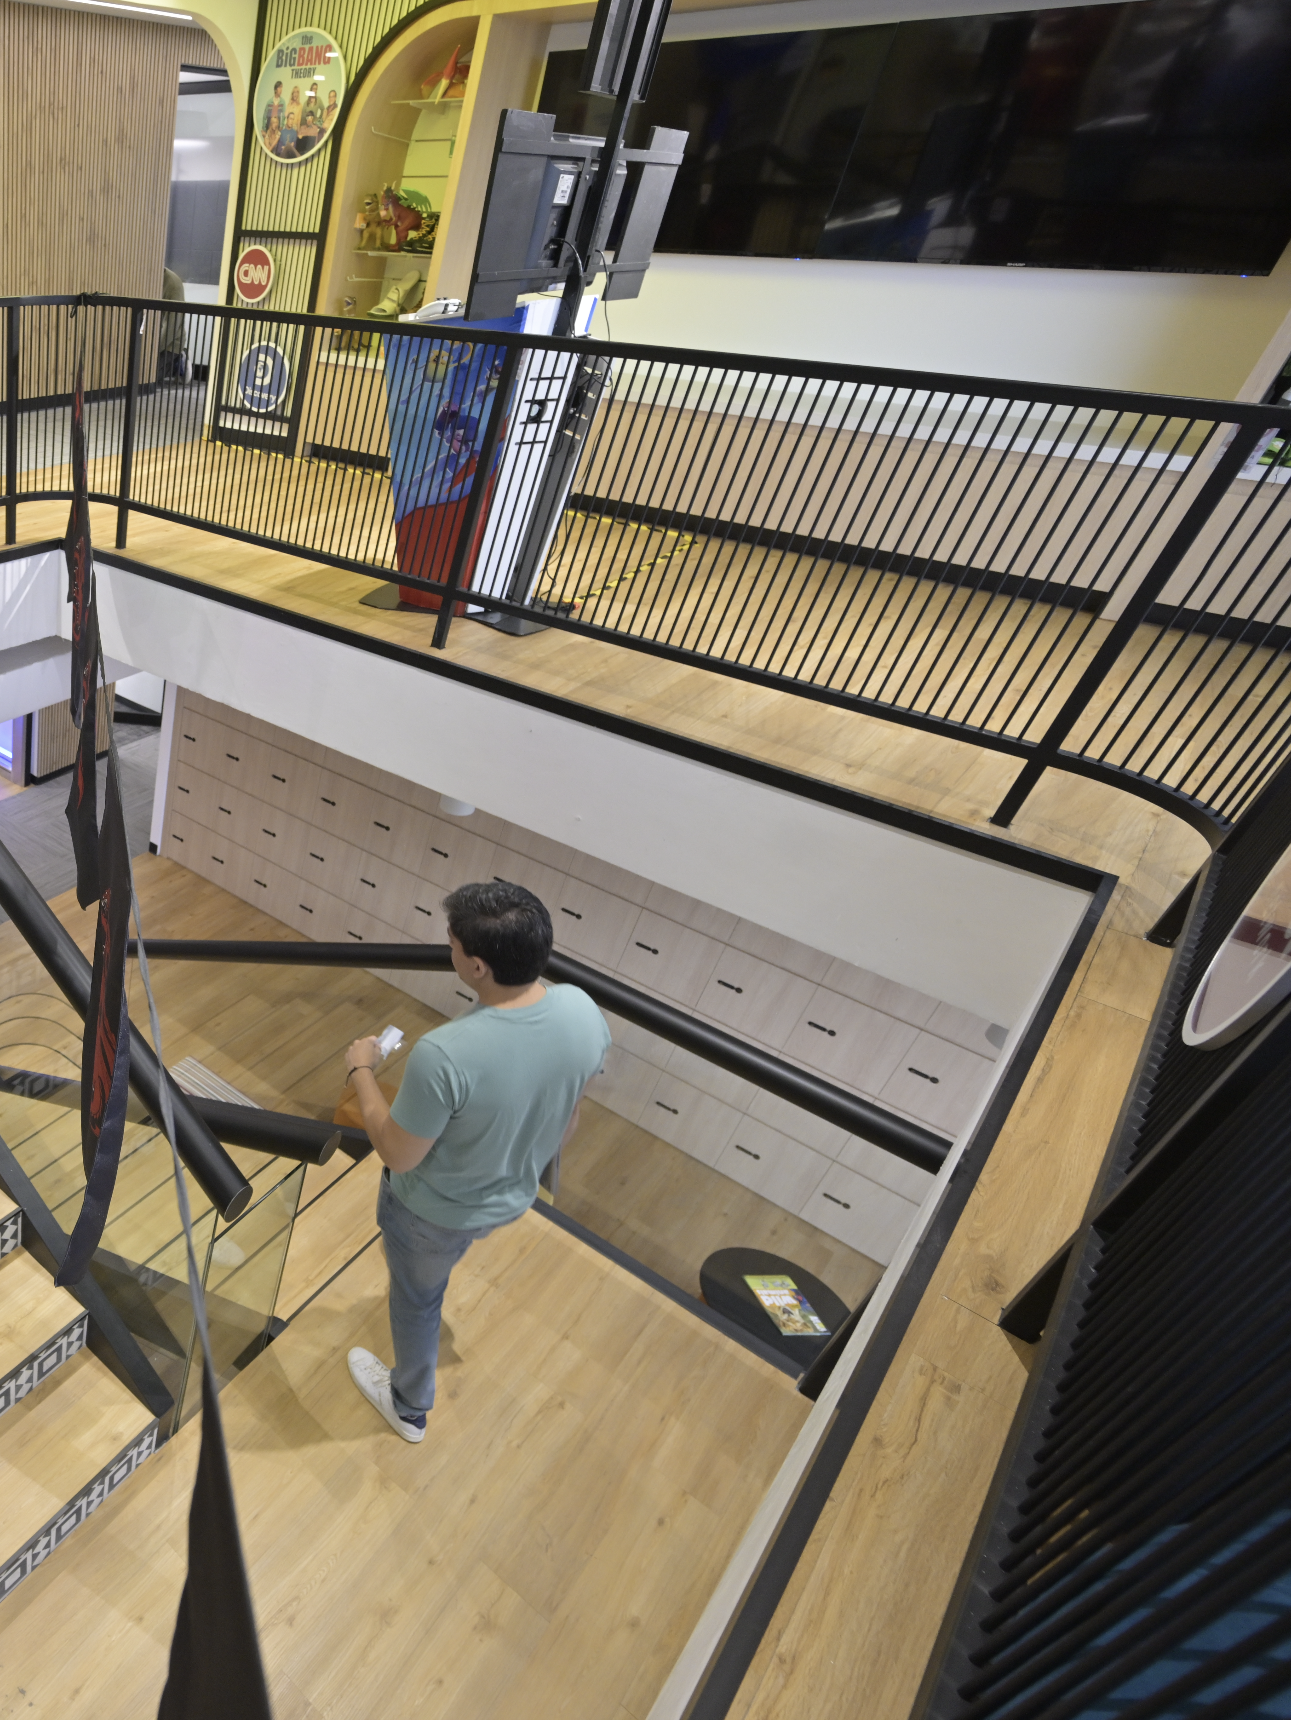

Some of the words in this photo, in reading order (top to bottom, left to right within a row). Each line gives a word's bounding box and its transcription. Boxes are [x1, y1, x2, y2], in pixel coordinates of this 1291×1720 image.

[301, 34, 314, 46] the
[290, 67, 317, 79] THEORY
[239, 263, 269, 286] CNN
